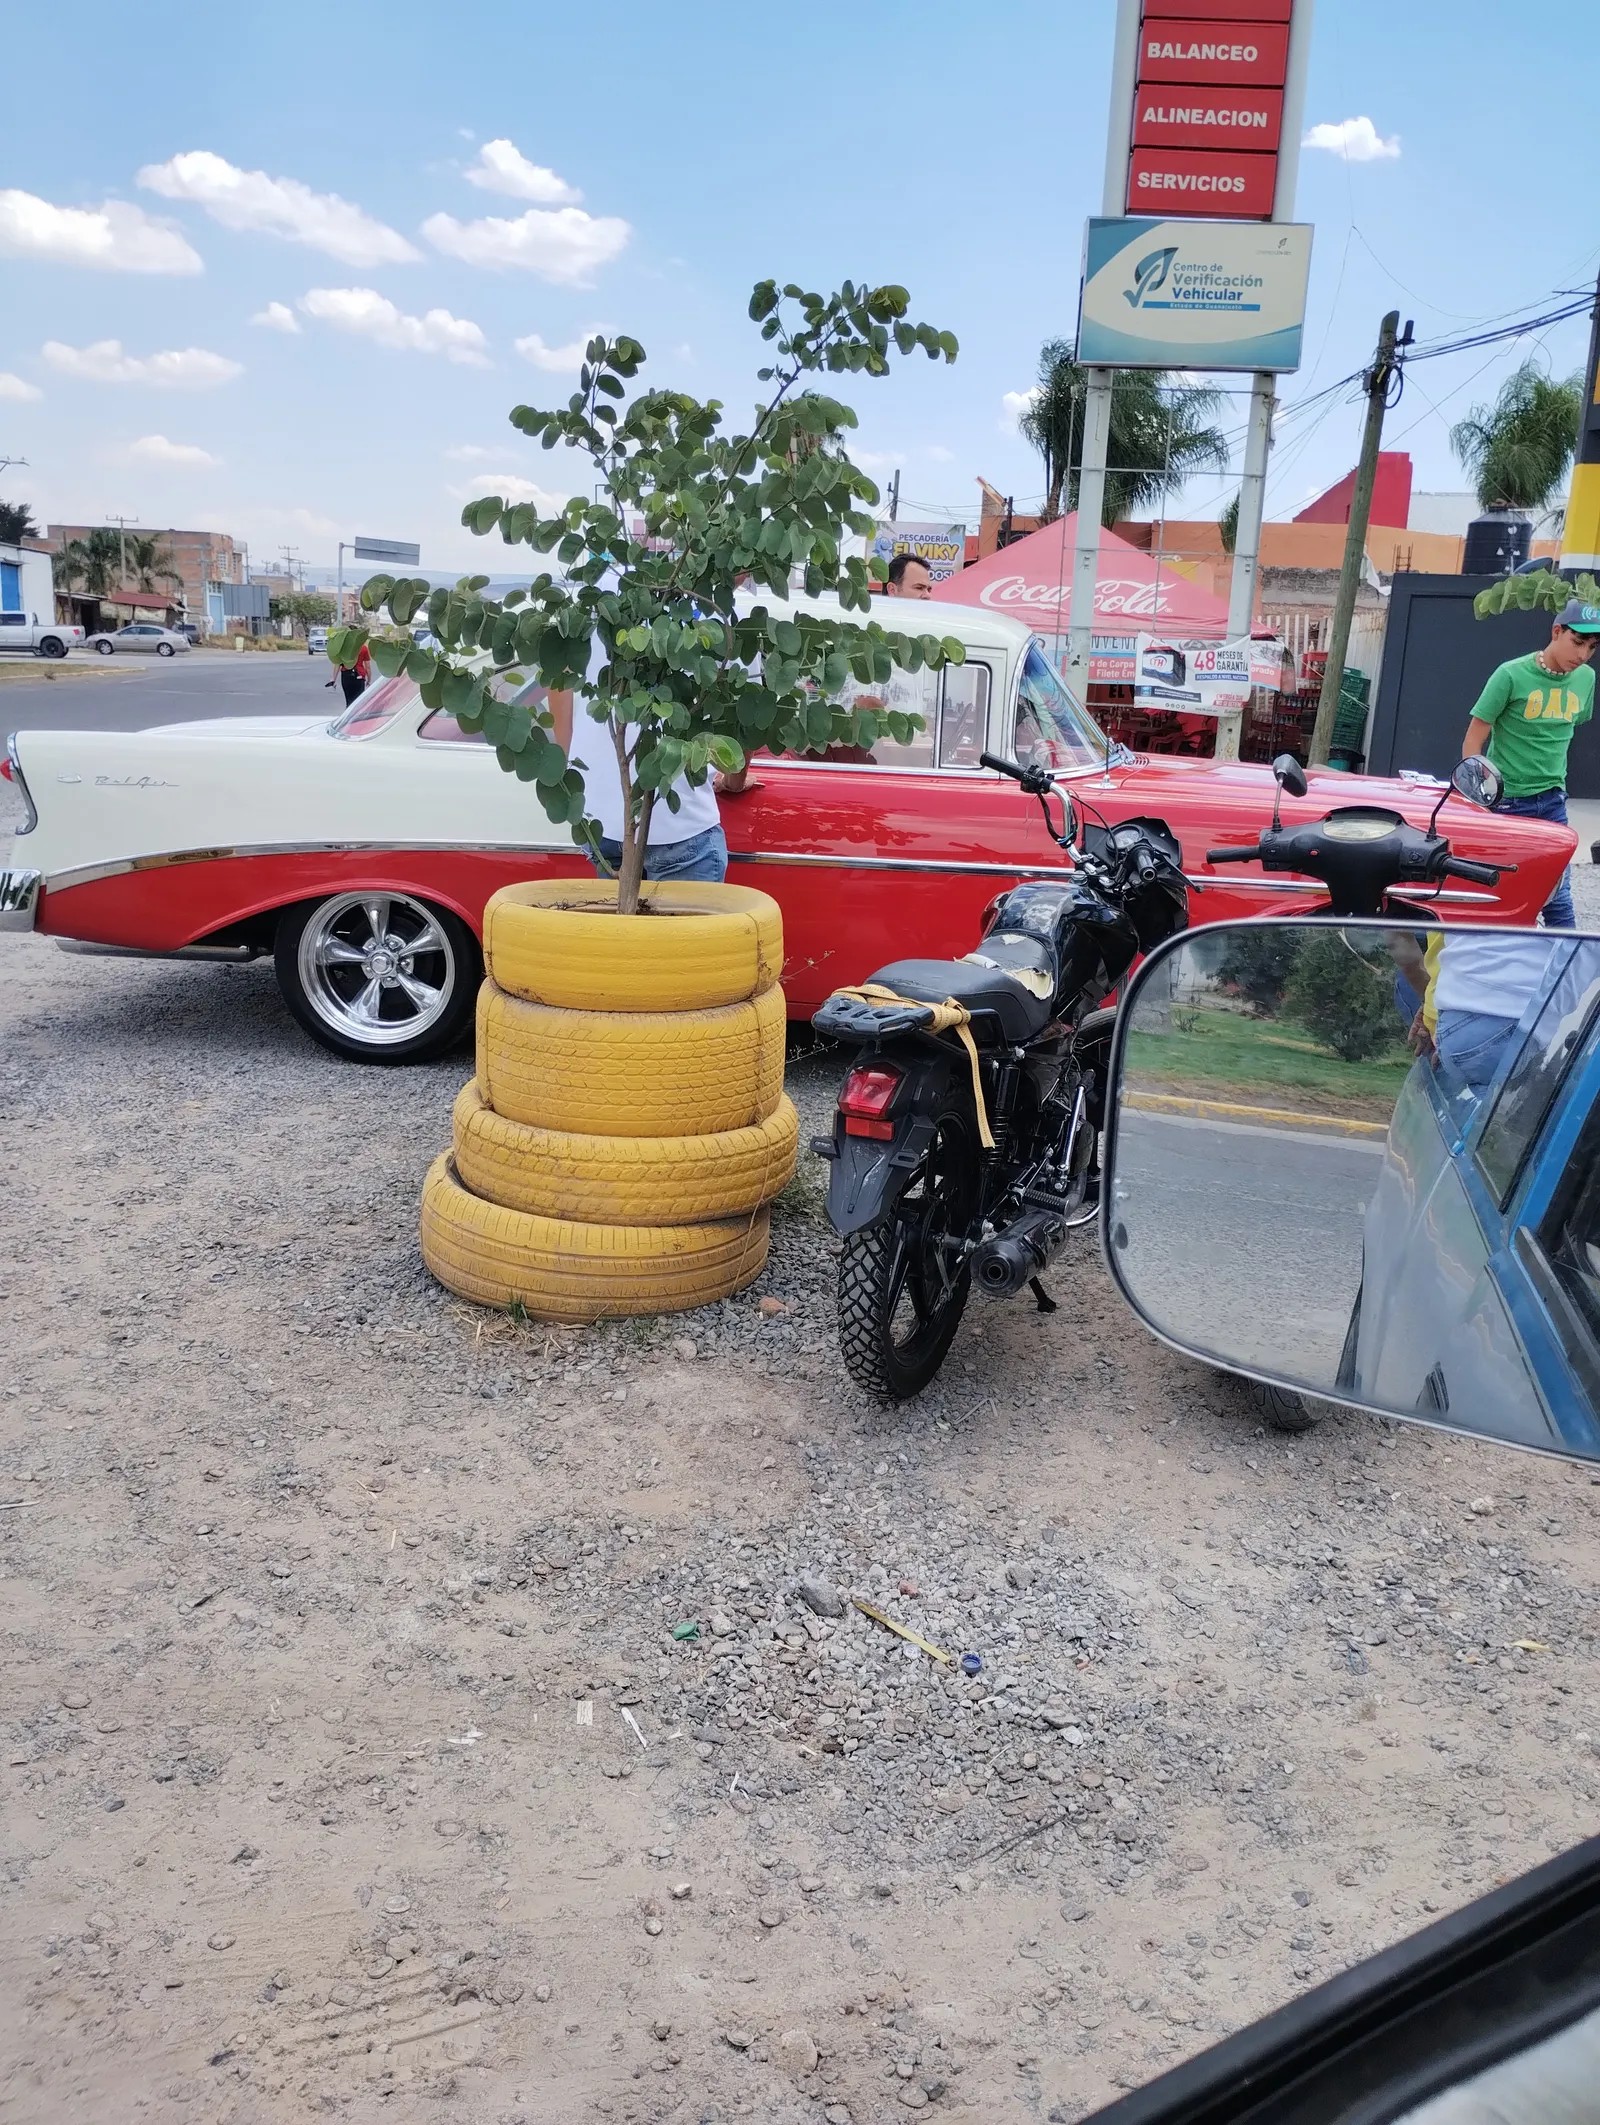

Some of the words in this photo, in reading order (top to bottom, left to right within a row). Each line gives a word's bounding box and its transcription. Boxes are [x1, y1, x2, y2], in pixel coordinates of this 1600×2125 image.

[1147, 42, 1258, 62] BALANCEO
[1142, 107, 1268, 128] ALINEACION
[1137, 172, 1246, 193] SERVICIOS
[1173, 263, 1208, 272] Centro
[1210, 264, 1223, 273] de
[1173, 273, 1263, 288] Verificación
[1172, 287, 1243, 301] Vehicular
[1204, 303, 1243, 311] Guanajuato
[899, 533, 949, 543] PESCADERÍA
[914, 542, 960, 561] VIKY
[980, 575, 1177, 615] CocaCola
[1194, 650, 1216, 671] 48
[1217, 651, 1236, 660] MESES
[1236, 651, 1244, 660] DE
[1097, 660, 1107, 668] de
[1109, 660, 1134, 669] Carpa
[1216, 660, 1249, 672] GARANTÍA
[1250, 666, 1275, 676] orado
[1096, 669, 1120, 678] Filete
